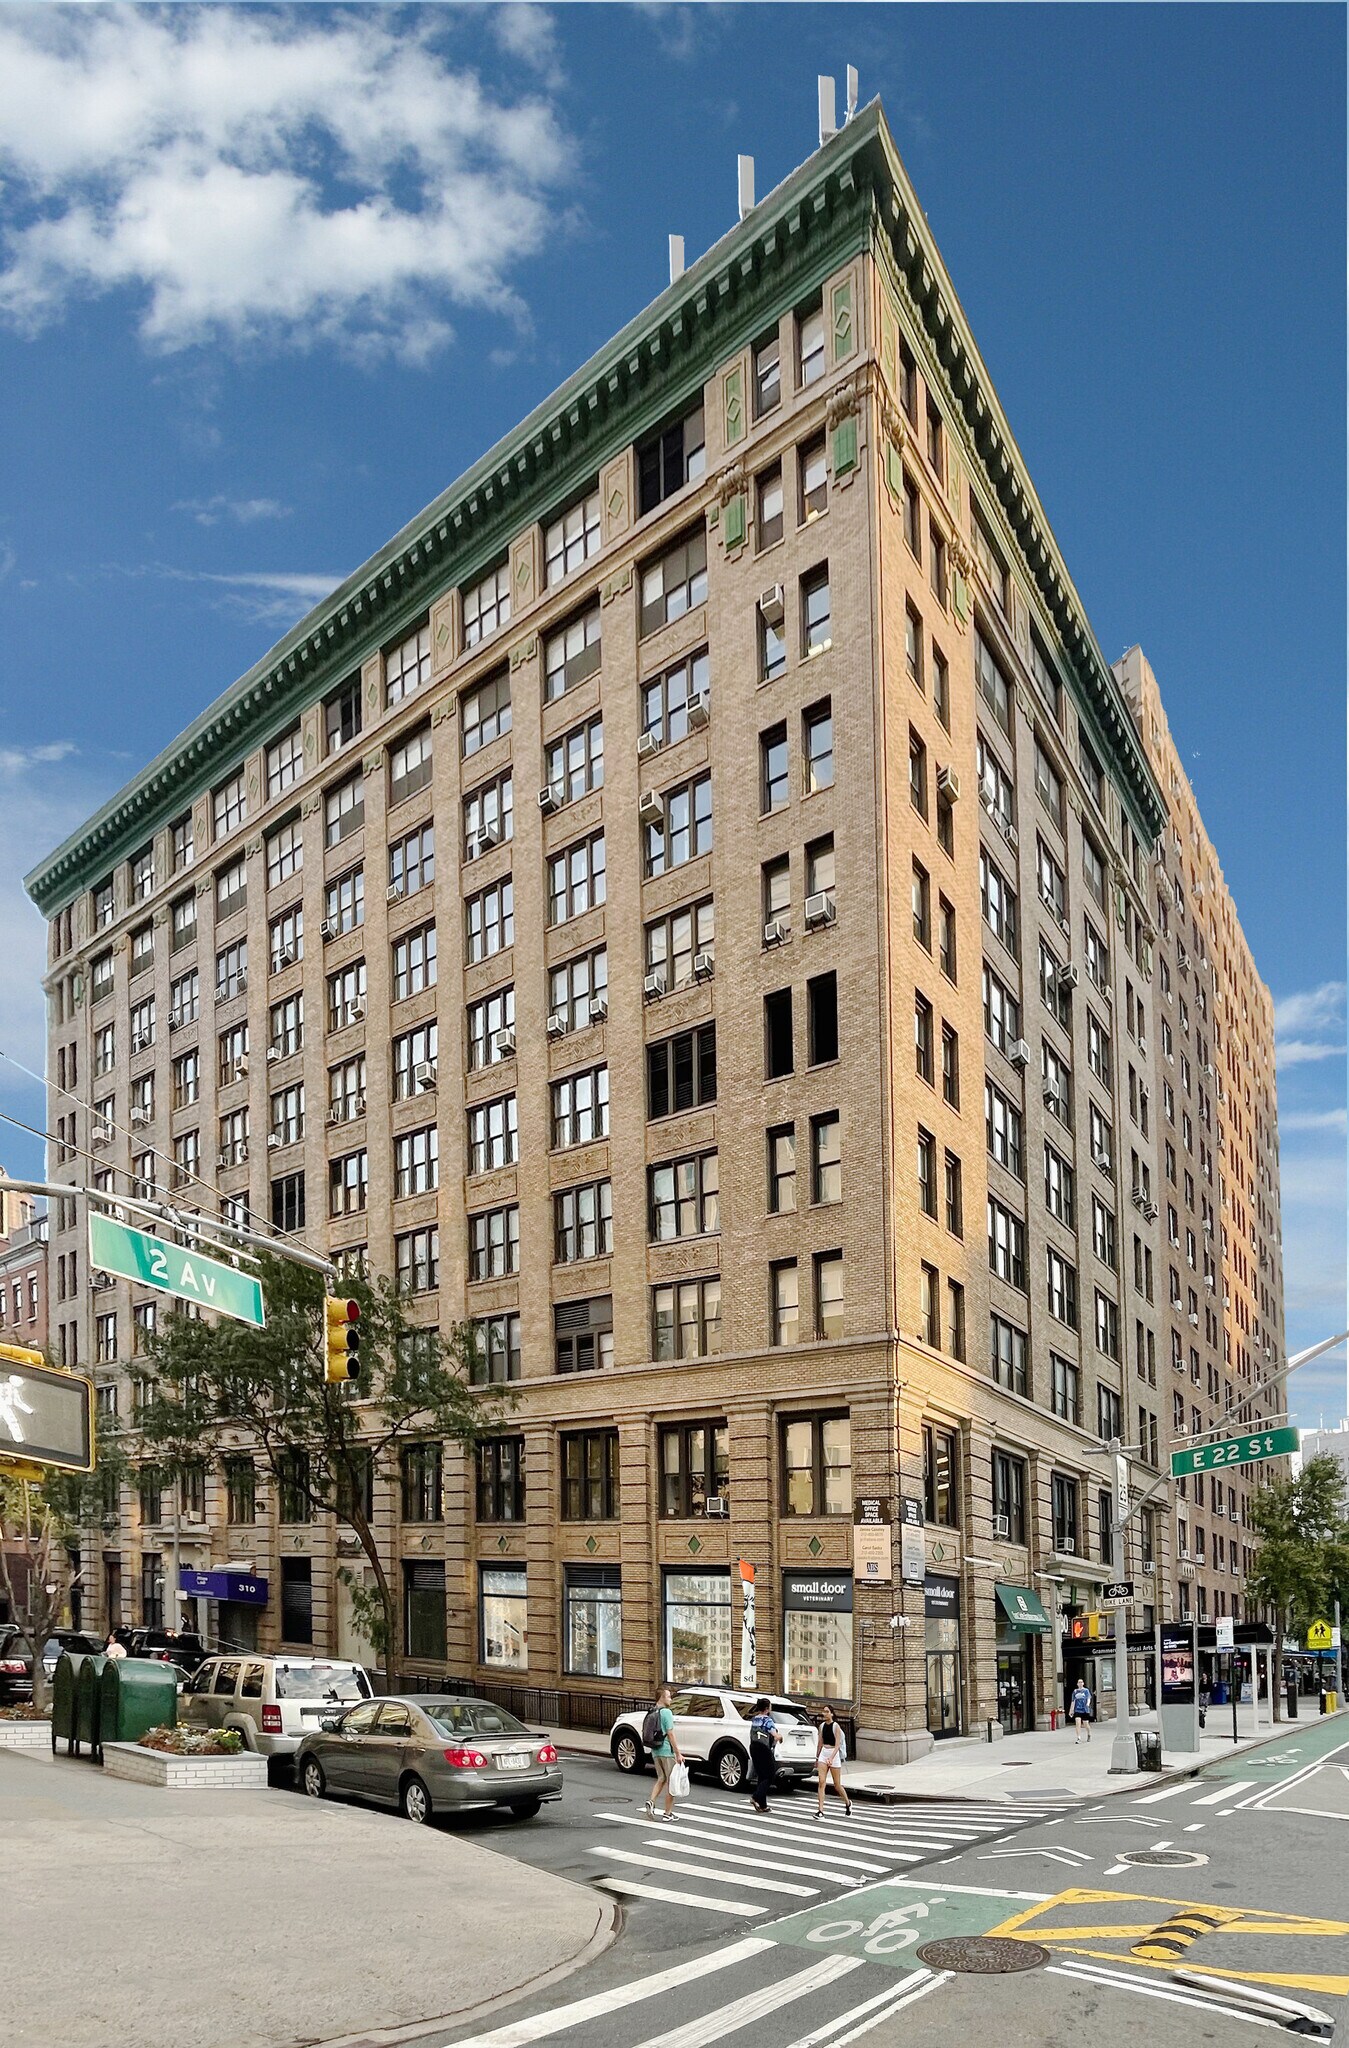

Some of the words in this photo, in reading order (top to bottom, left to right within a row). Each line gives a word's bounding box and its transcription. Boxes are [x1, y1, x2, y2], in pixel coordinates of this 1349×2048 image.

[149, 1248, 169, 1280] 2
[179, 1261, 216, 1297] Av
[1193, 1451, 1205, 1468] E
[1212, 1444, 1240, 1464] 22
[1248, 1436, 1274, 1456] St
[239, 1584, 256, 1593] 310
[791, 1581, 819, 1593] small
[820, 1582, 846, 1594] door
[941, 1587, 955, 1599] door
[1119, 1597, 1133, 1605] LANE
[743, 1674, 754, 1682] sd
